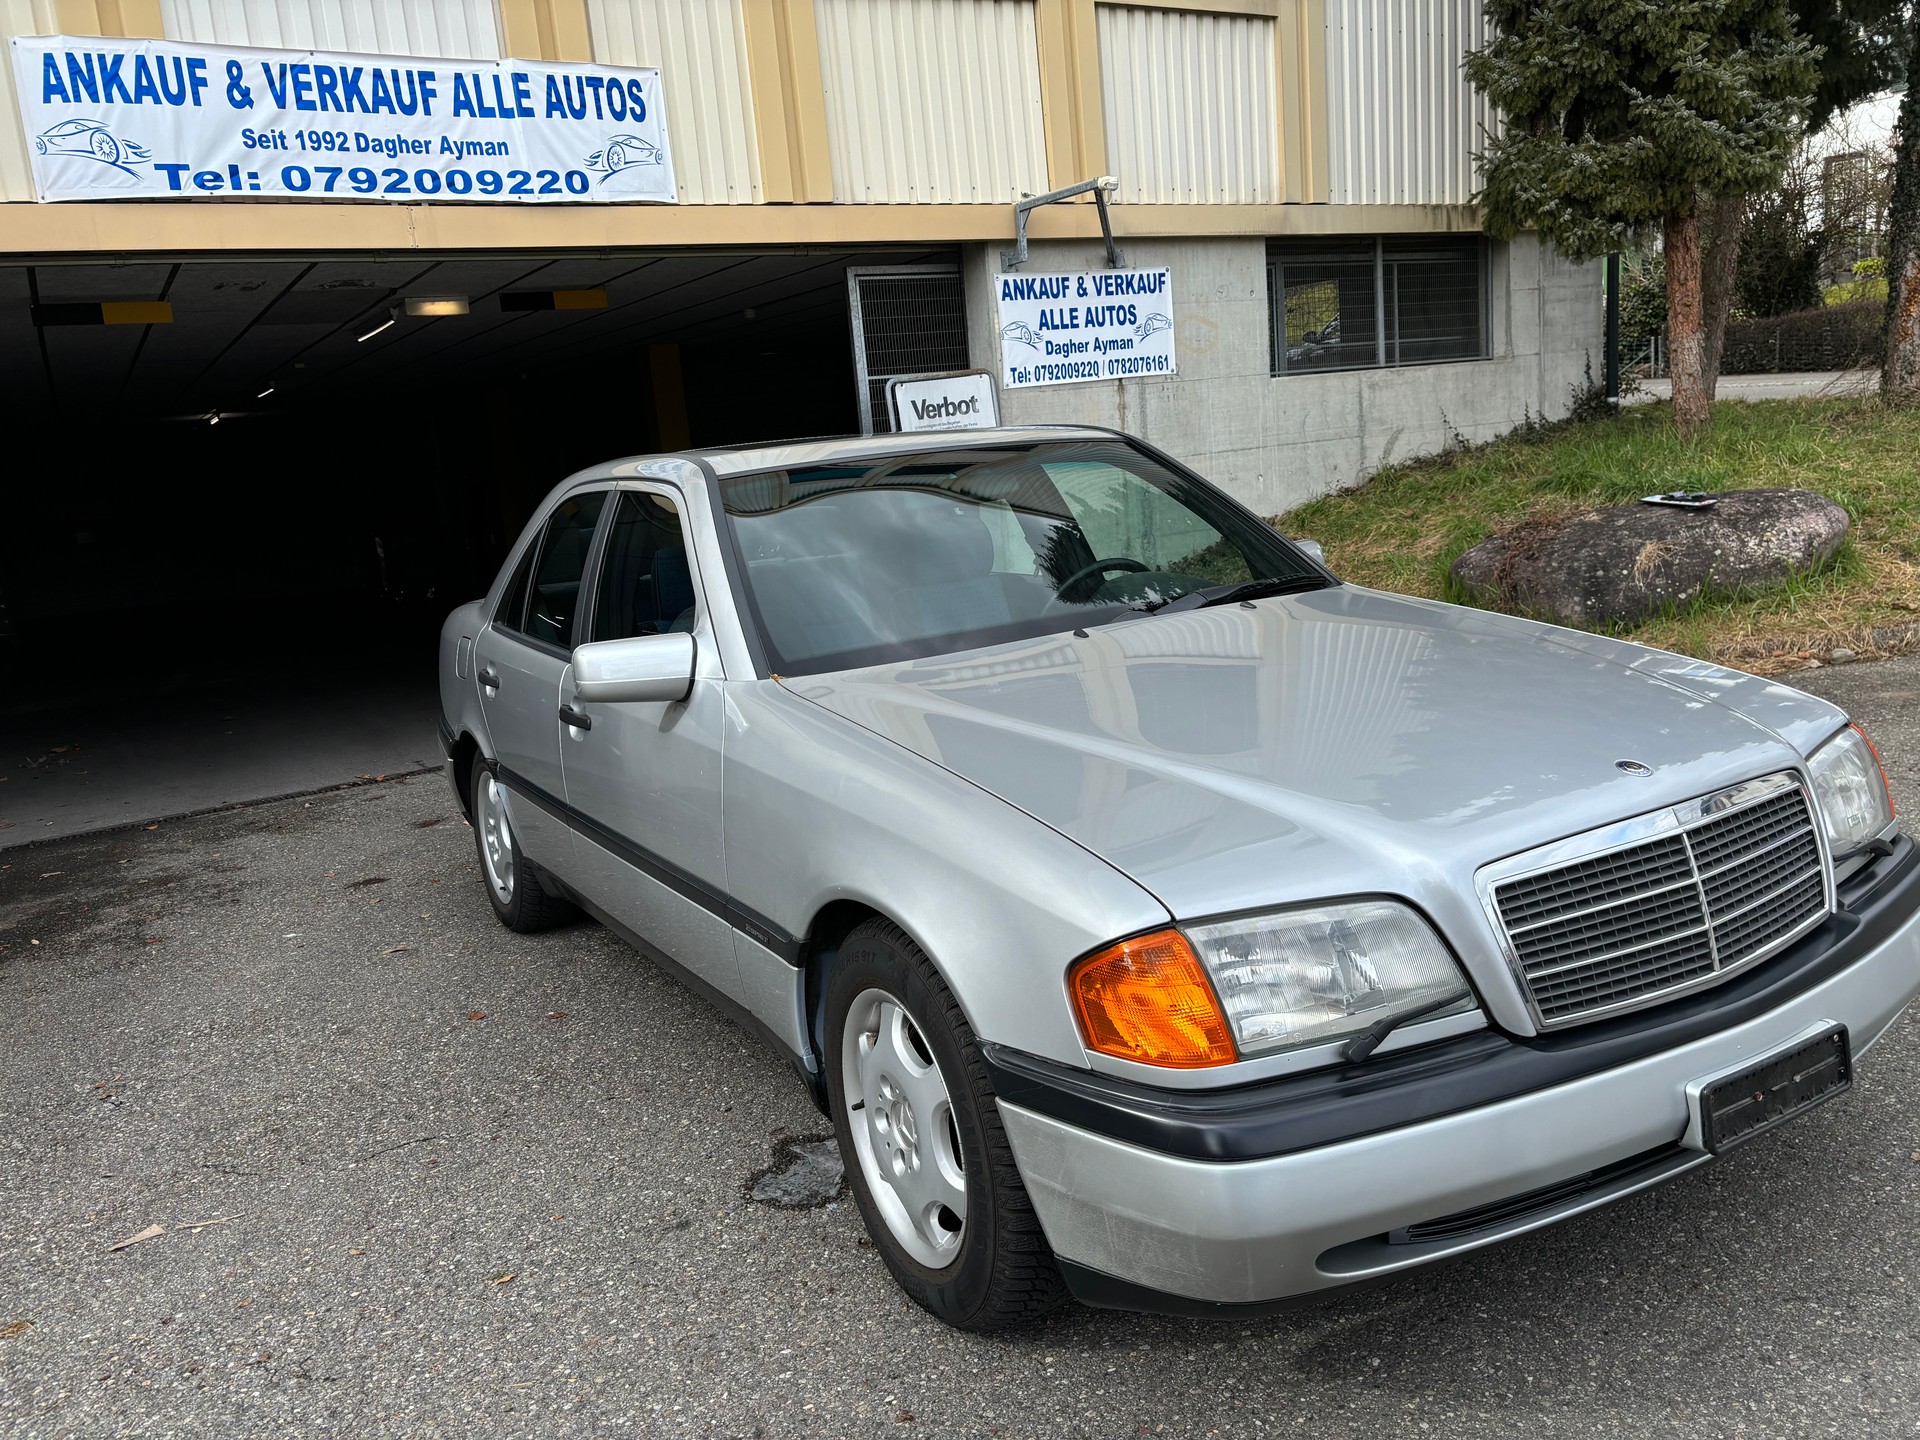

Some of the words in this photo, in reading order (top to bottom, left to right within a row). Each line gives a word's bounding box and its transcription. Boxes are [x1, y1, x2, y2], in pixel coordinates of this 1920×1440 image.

[42, 52, 208, 107] ANKAUF
[226, 59, 254, 110] &
[260, 62, 438, 116] VERKAUF
[453, 72, 535, 119] ALLE
[545, 74, 646, 122] AUTOS
[242, 128, 288, 150] Seit
[295, 130, 350, 152] 1992
[357, 132, 431, 159] Dagher
[439, 135, 509, 161] Ayman
[154, 163, 261, 191] Tel:
[281, 165, 590, 195] 0792009220
[1001, 276, 1070, 301] ANKAUF
[1076, 276, 1089, 298] &
[1092, 272, 1166, 297] VERKAUF
[1038, 307, 1080, 331] ALLE
[1084, 304, 1138, 328] AUTOS
[1045, 340, 1090, 359] Dagher
[1093, 337, 1134, 356] Ayman
[1010, 366, 1032, 384] Tel:
[1034, 360, 1099, 383] 0792009220
[1108, 354, 1169, 376] 0782076161
[910, 395, 980, 420] Verbot
